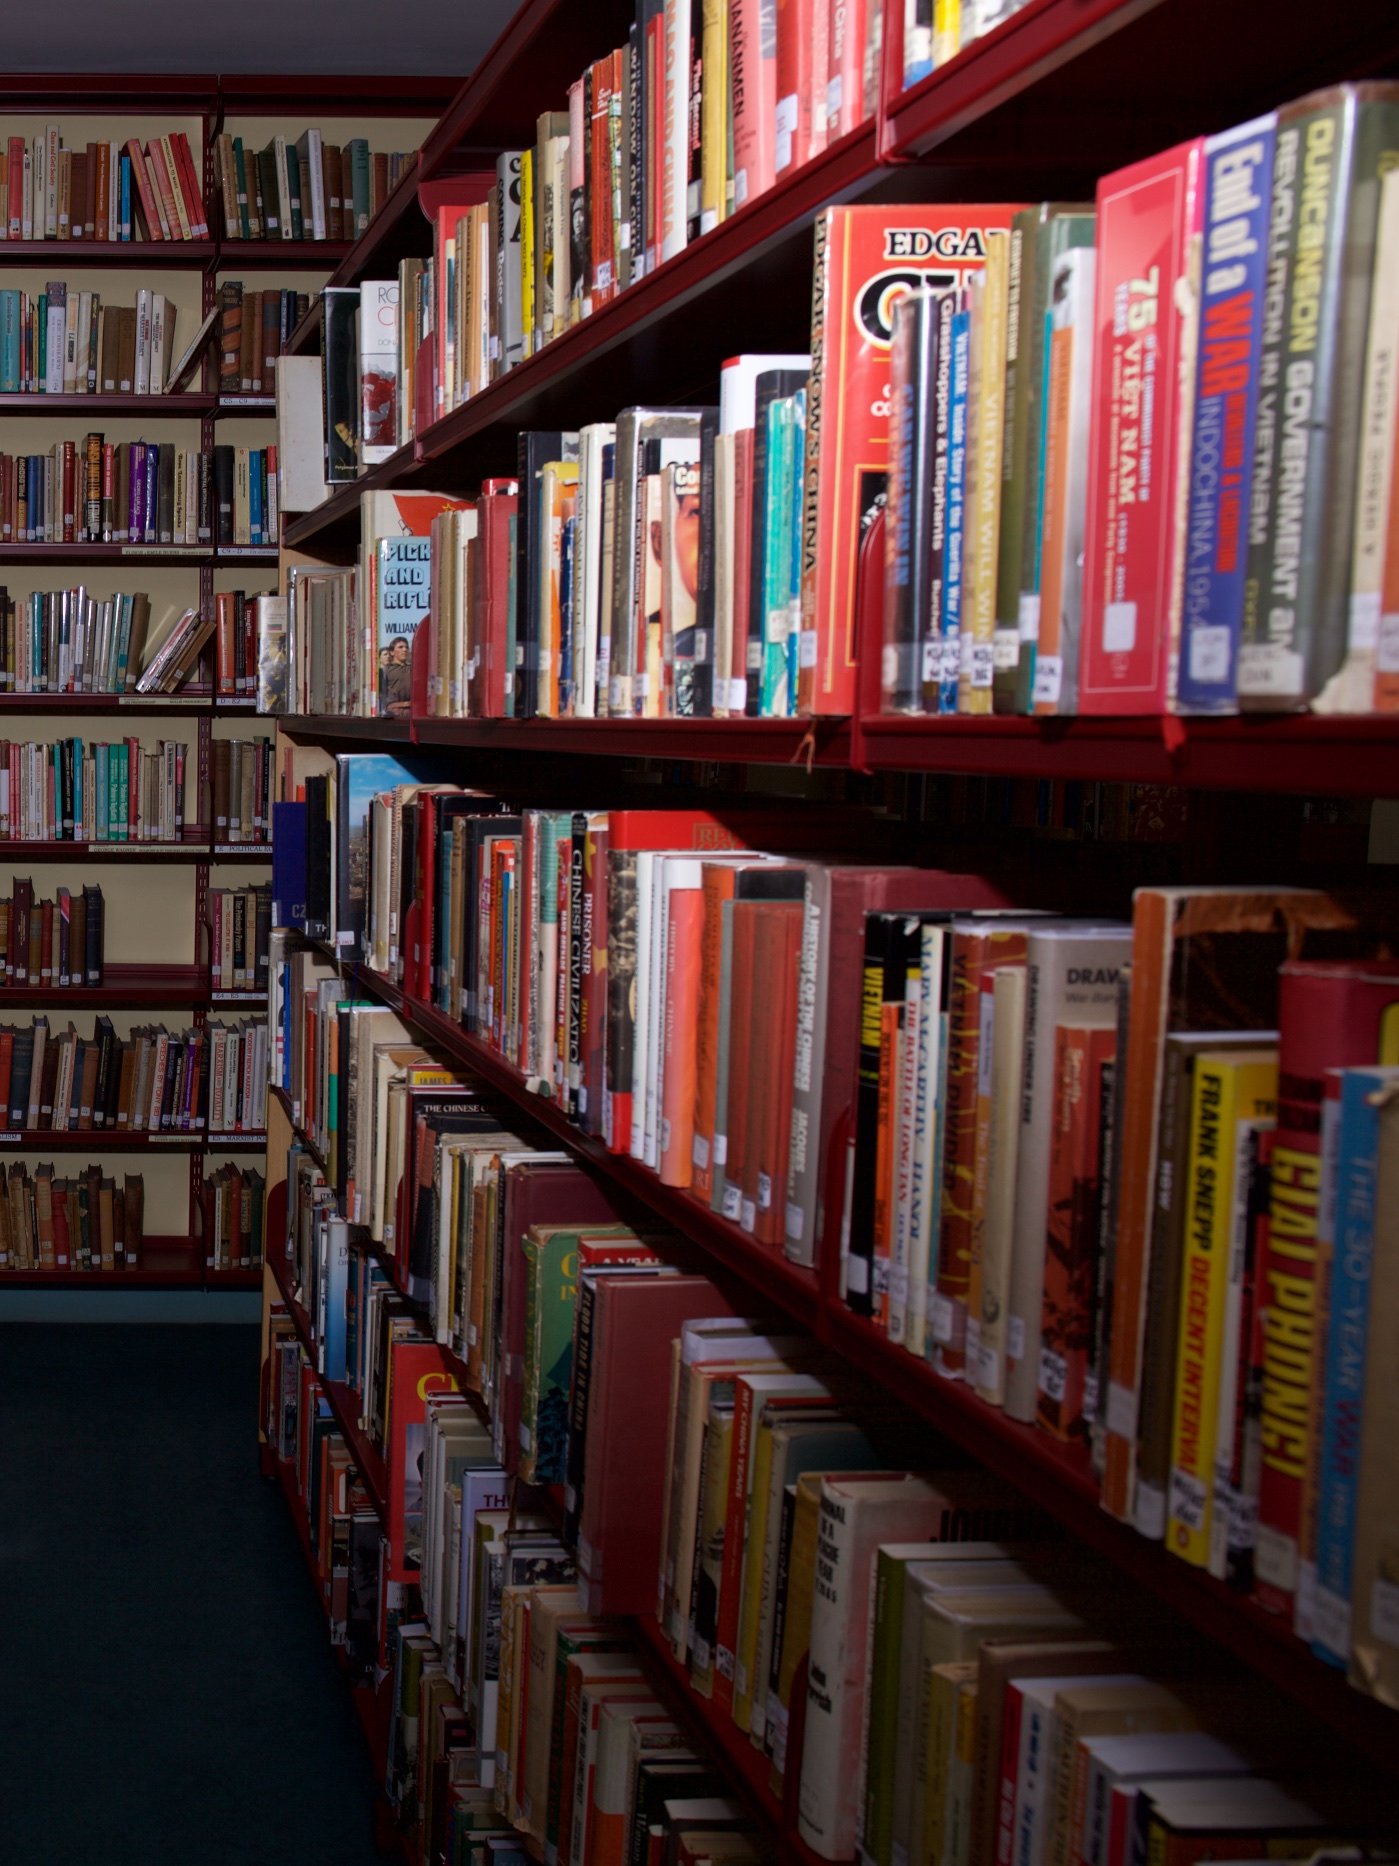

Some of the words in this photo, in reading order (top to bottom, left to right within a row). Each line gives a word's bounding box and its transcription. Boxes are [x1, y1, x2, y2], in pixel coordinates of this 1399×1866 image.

[692, 58, 703, 86] The
[629, 47, 638, 159] WINDOW
[663, 77, 675, 133] AND
[692, 87, 703, 149] Second
[629, 164, 637, 197] ON
[662, 135, 674, 246] CHINA
[1206, 140, 1265, 223] End
[497, 178, 505, 248] COMING
[629, 203, 637, 280] CHINA
[1206, 216, 1258, 265] of
[1263, 129, 1300, 345] REVOLUTION
[812, 214, 828, 337] EDGAR
[1204, 263, 1247, 296] a
[1112, 281, 1130, 338] YEARS
[1128, 265, 1160, 331] 75
[933, 297, 953, 435] Grasshoppers
[1199, 290, 1254, 398] WAR
[1258, 352, 1281, 388] IN
[932, 436, 950, 453] &
[950, 402, 967, 447] Inside
[947, 448, 966, 485] Story
[979, 391, 999, 513] VIETNAM
[1117, 426, 1138, 504] NAM
[18, 458, 26, 498] PHILOSOPHY
[176, 470, 184, 507] Luxemburg
[1270, 359, 1316, 602] GOVERNMENT
[18, 499, 26, 528] MARXIST
[803, 460, 820, 576] CHINA
[930, 455, 949, 551] Elephants
[948, 503, 964, 530] the
[383, 543, 432, 562] PICK
[977, 517, 997, 583] WILL
[383, 567, 424, 585] AND
[945, 584, 962, 612] War
[245, 609, 253, 637] Imagine
[110, 783, 119, 802] Palmiro
[110, 801, 119, 822] Togliatti
[119, 783, 128, 802] Palmiro
[119, 801, 128, 822] Togliatti
[571, 848, 582, 936] CHINESE
[808, 905, 821, 918] A
[582, 891, 594, 976] PRISONER
[804, 917, 819, 984] HISTORY
[558, 972, 567, 1013] PRACTICE
[569, 939, 581, 1062] CIVILIZATIO
[802, 984, 815, 1002] OF
[861, 966, 885, 1048] VIETNAM
[949, 952, 968, 1077] VIETNAM
[1028, 965, 1041, 1038] DRAWING
[580, 998, 588, 1034] ZHAO
[800, 1002, 814, 1031] THE
[157, 1037, 168, 1073] SPEECHES
[216, 1042, 224, 1077] MARXISM
[557, 1026, 565, 1057] PEKING
[797, 1031, 812, 1094] CHINESE
[904, 1034, 916, 1093] BATTLE
[156, 1074, 164, 1084] BY
[419, 1077, 447, 1085] JAMES
[912, 1009, 930, 1142] McCARTHY
[1025, 1040, 1036, 1091] UNDER
[155, 1085, 163, 1104] TONY
[214, 1087, 223, 1121] TOTALITY
[423, 1104, 441, 1113] THE
[443, 1104, 480, 1113] CHINESE
[1022, 1094, 1033, 1125] FIRE
[1196, 1073, 1222, 1160] FRANK
[795, 1110, 809, 1174] JACQUES
[900, 1122, 912, 1164] LONG
[943, 1083, 961, 1191] DIVIDED
[898, 1168, 909, 1202] TAN
[909, 1161, 925, 1242] HANOI
[1270, 1144, 1321, 1264] GIAI
[1349, 1154, 1376, 1221] THE
[1192, 1166, 1220, 1252] SNEPP
[581, 1292, 593, 1335] FLOOD
[1185, 1254, 1212, 1352] DECENT
[578, 1338, 591, 1370] TIDE
[575, 1374, 587, 1390] IN
[740, 1389, 751, 1410] MY
[572, 1393, 586, 1432] CHINA
[737, 1416, 750, 1454] CHINA
[1330, 1400, 1362, 1477] WAR
[735, 1457, 747, 1500] YEARS
